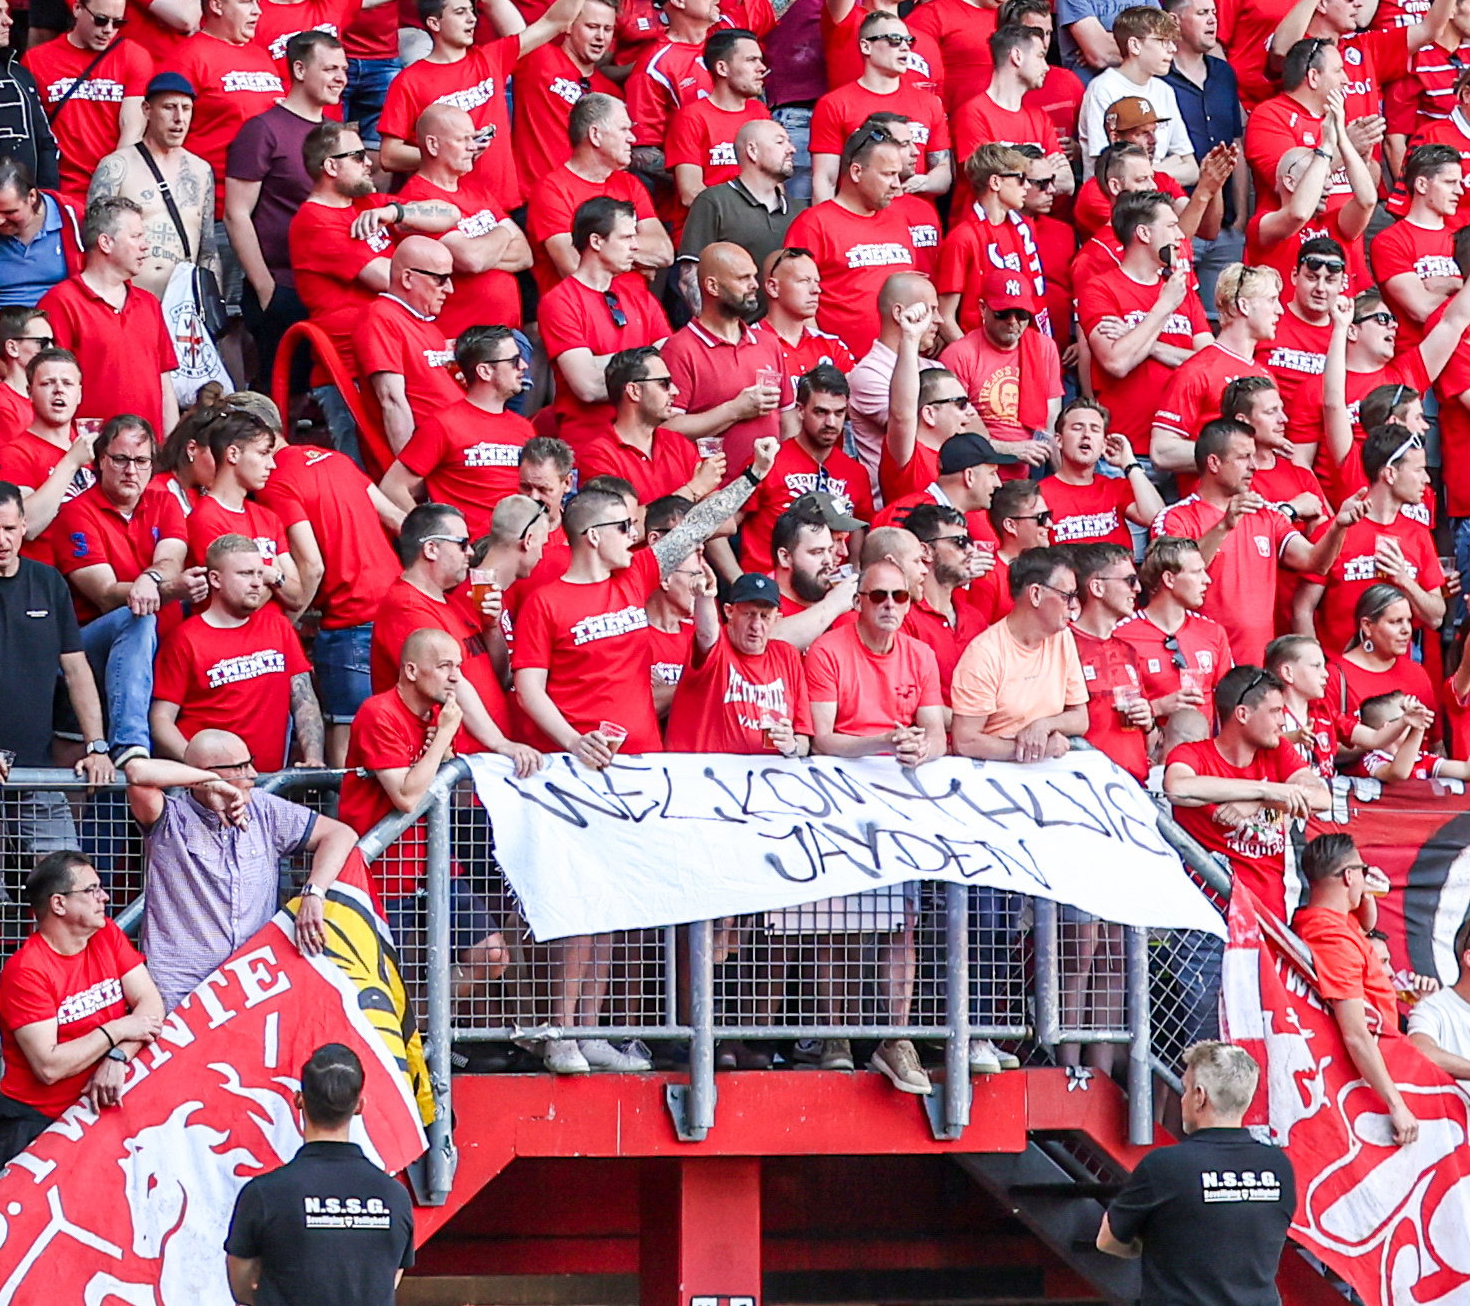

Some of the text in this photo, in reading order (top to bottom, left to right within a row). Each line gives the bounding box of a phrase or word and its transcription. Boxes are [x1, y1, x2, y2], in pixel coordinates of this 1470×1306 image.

[759, 818, 1052, 890] JAYDEN
[1201, 1171, 1281, 1190] N.S.S.G.
[304, 1197, 390, 1215] N.S.S.G.
